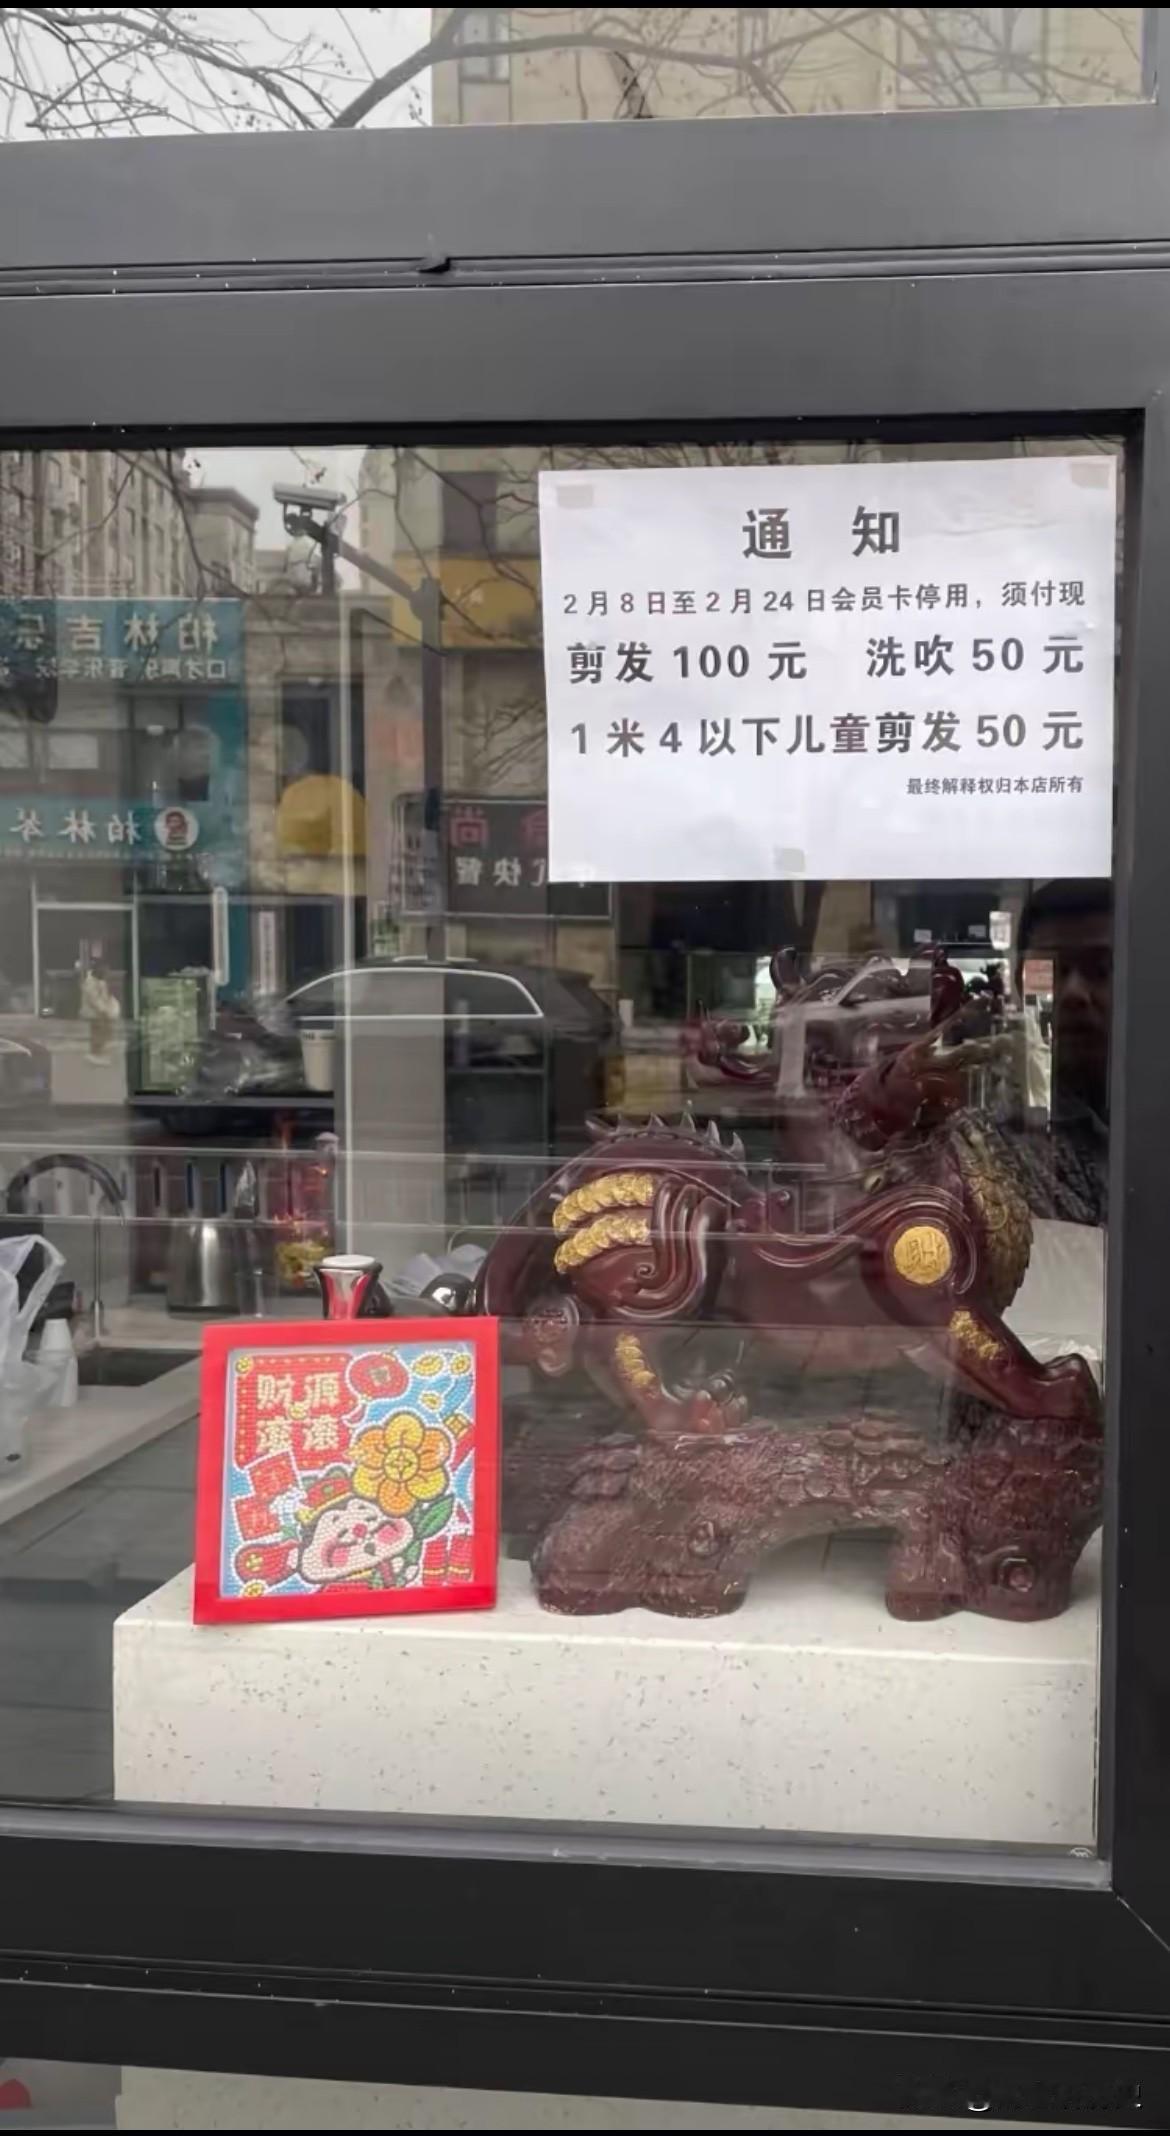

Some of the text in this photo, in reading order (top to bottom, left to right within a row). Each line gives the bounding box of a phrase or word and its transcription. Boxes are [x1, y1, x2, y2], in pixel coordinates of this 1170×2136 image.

[742, 505, 901, 559] 通知
[567, 633, 1084, 684] 剪发100元 洗吹50元
[571, 709, 1084, 758] 1米4以下儿童剪发50元
[907, 776, 1083, 796] 最终解释权归本店所有
[256, 1372, 340, 1409] 财源
